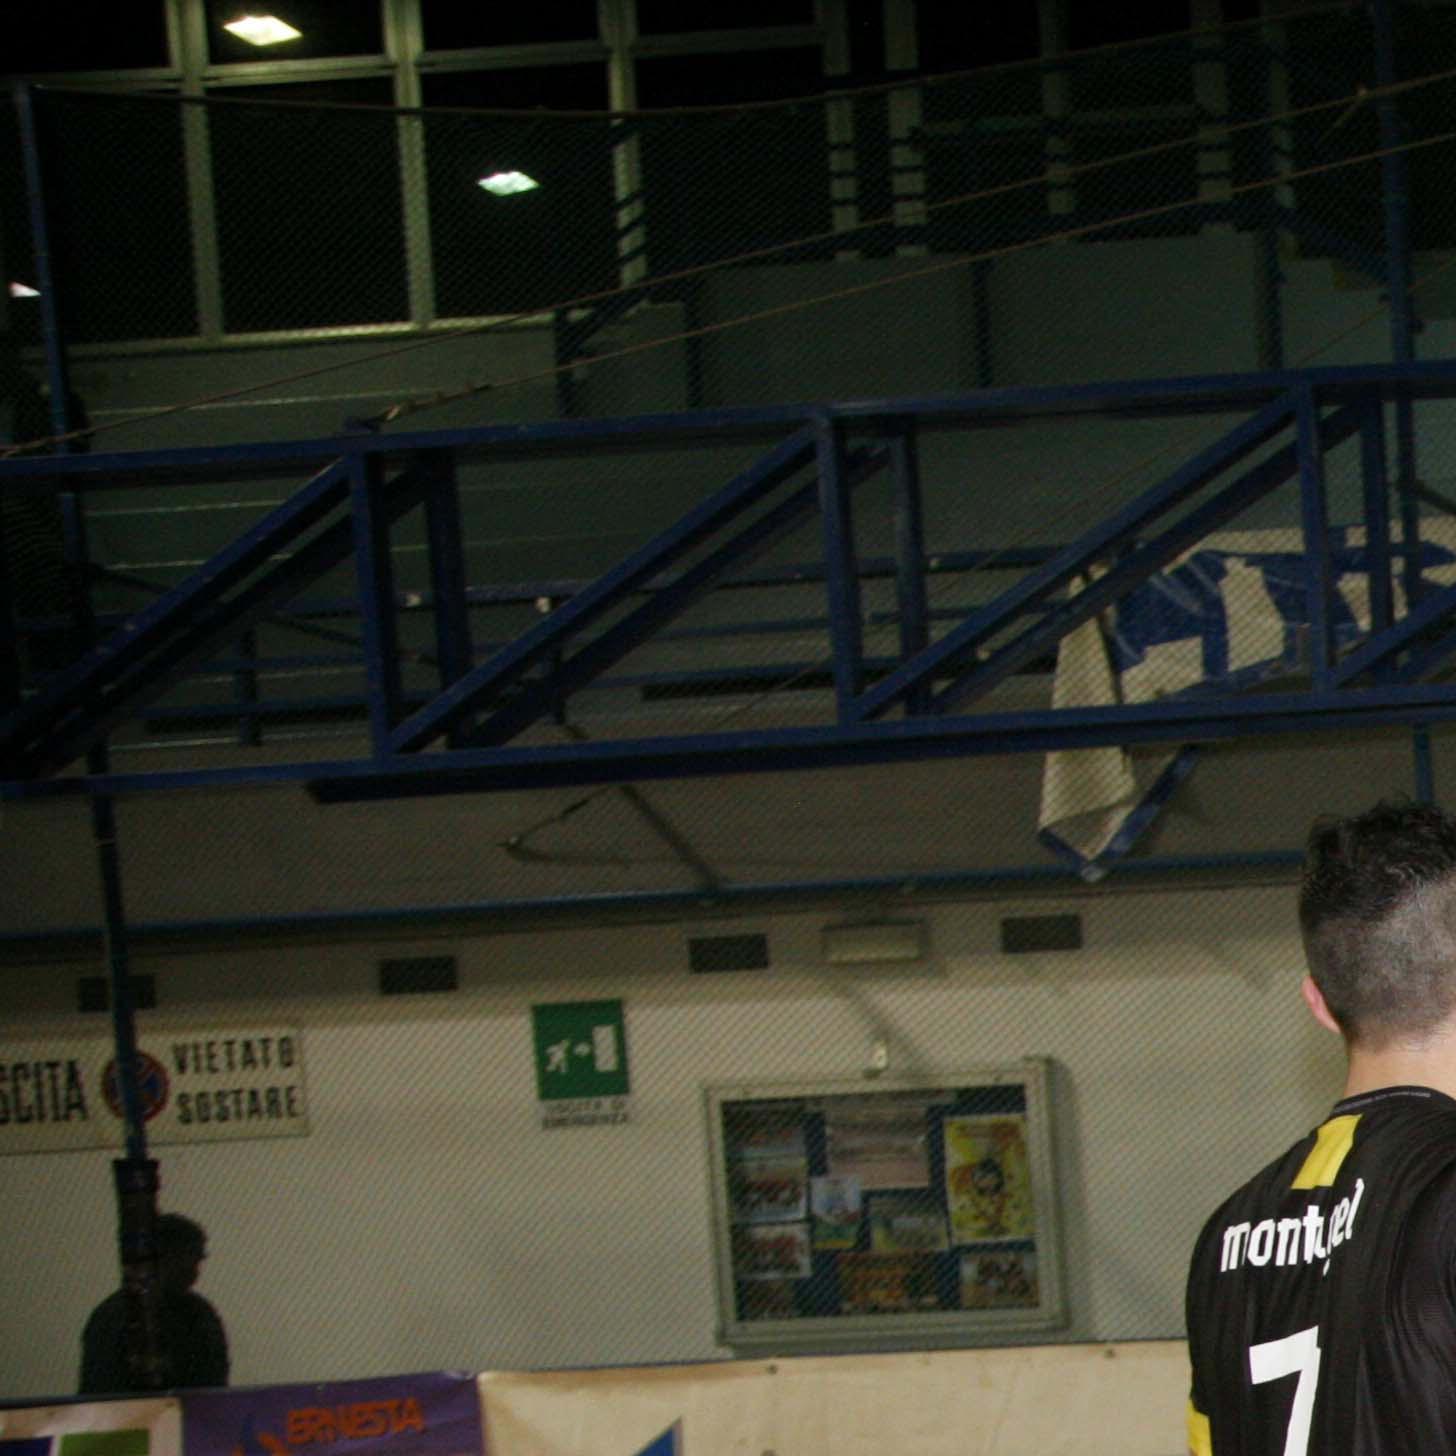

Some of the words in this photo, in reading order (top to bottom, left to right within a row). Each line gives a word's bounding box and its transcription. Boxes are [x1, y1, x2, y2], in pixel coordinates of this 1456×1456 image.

[173, 1035, 296, 1075] VIETATO
[176, 1085, 300, 1126] SOSTARE
[286, 1396, 426, 1445] ERNESTA
